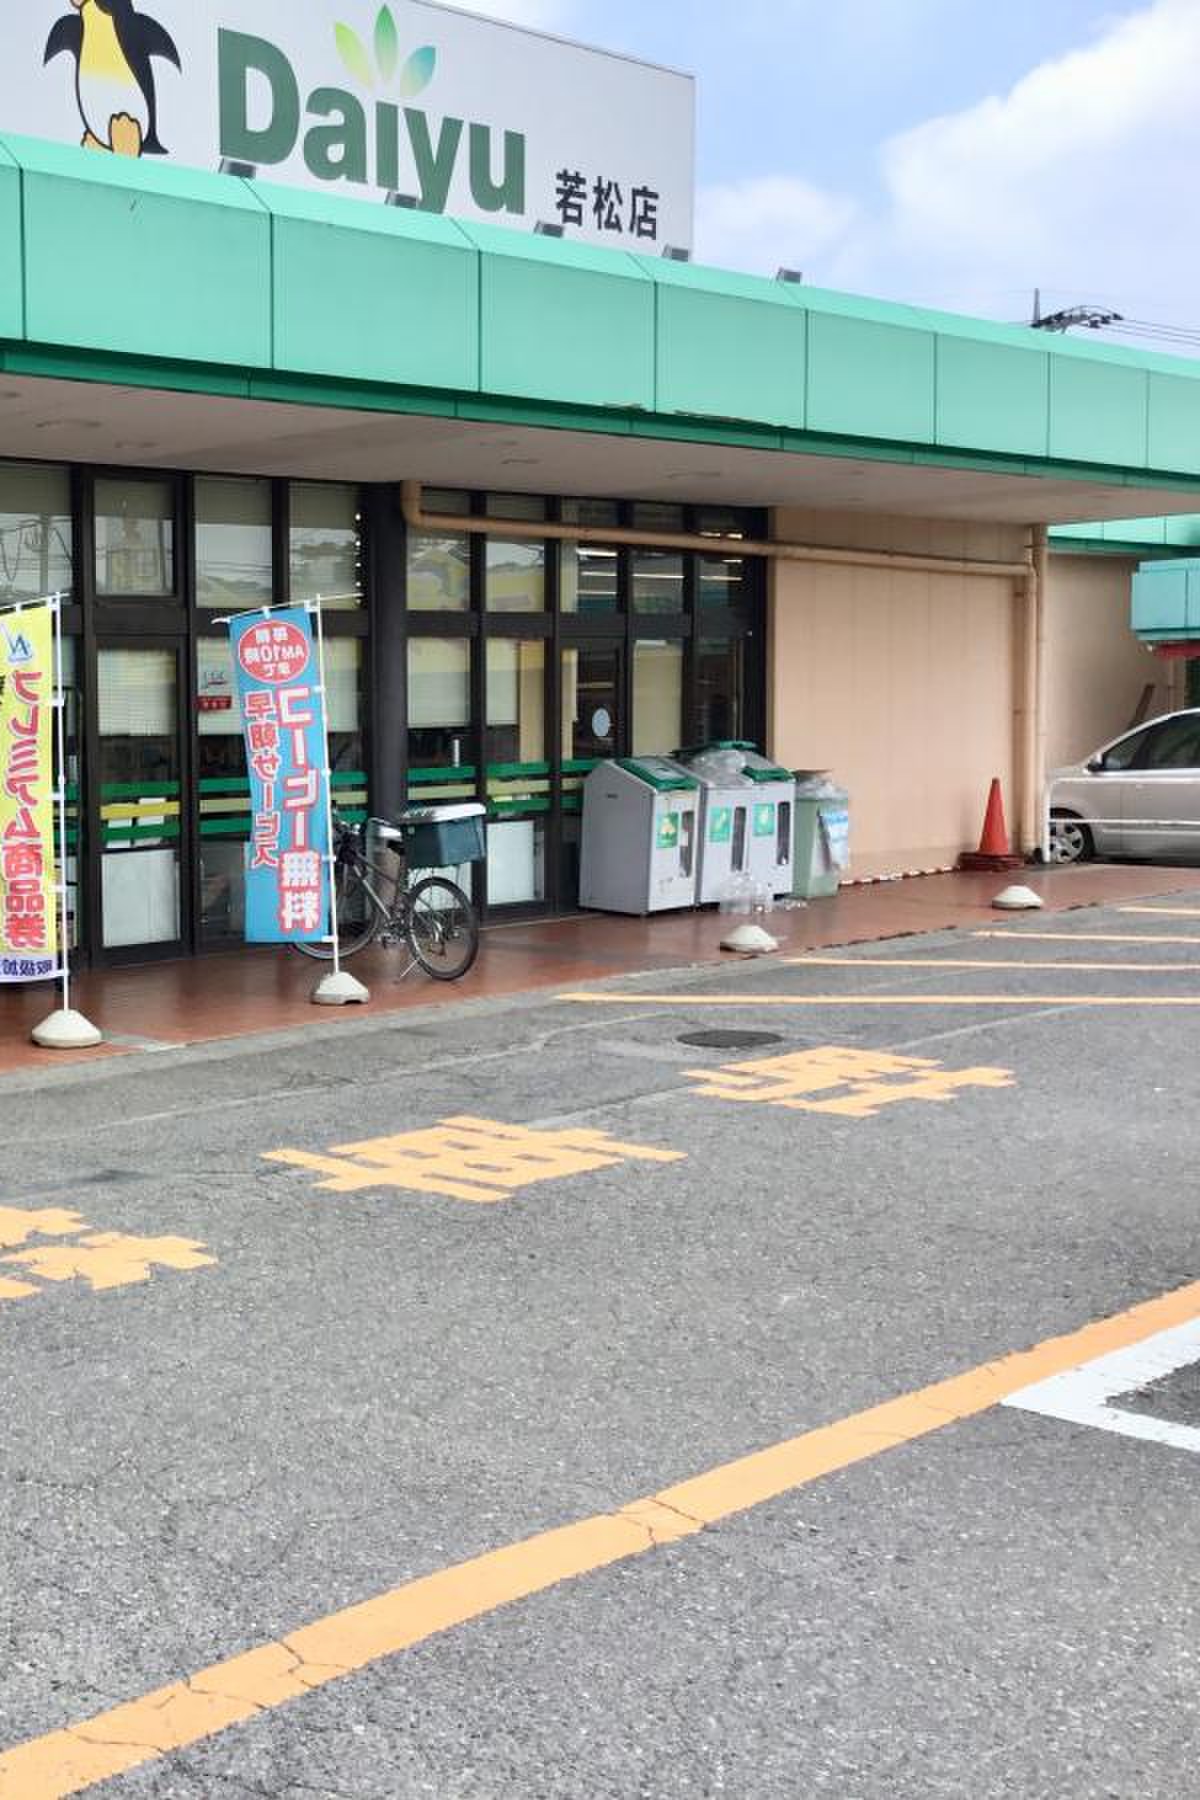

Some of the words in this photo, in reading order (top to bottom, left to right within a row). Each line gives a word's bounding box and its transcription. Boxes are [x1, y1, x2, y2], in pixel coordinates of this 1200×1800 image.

[218, 27, 525, 214] Daiyu
[555, 169, 660, 240] 若松店
